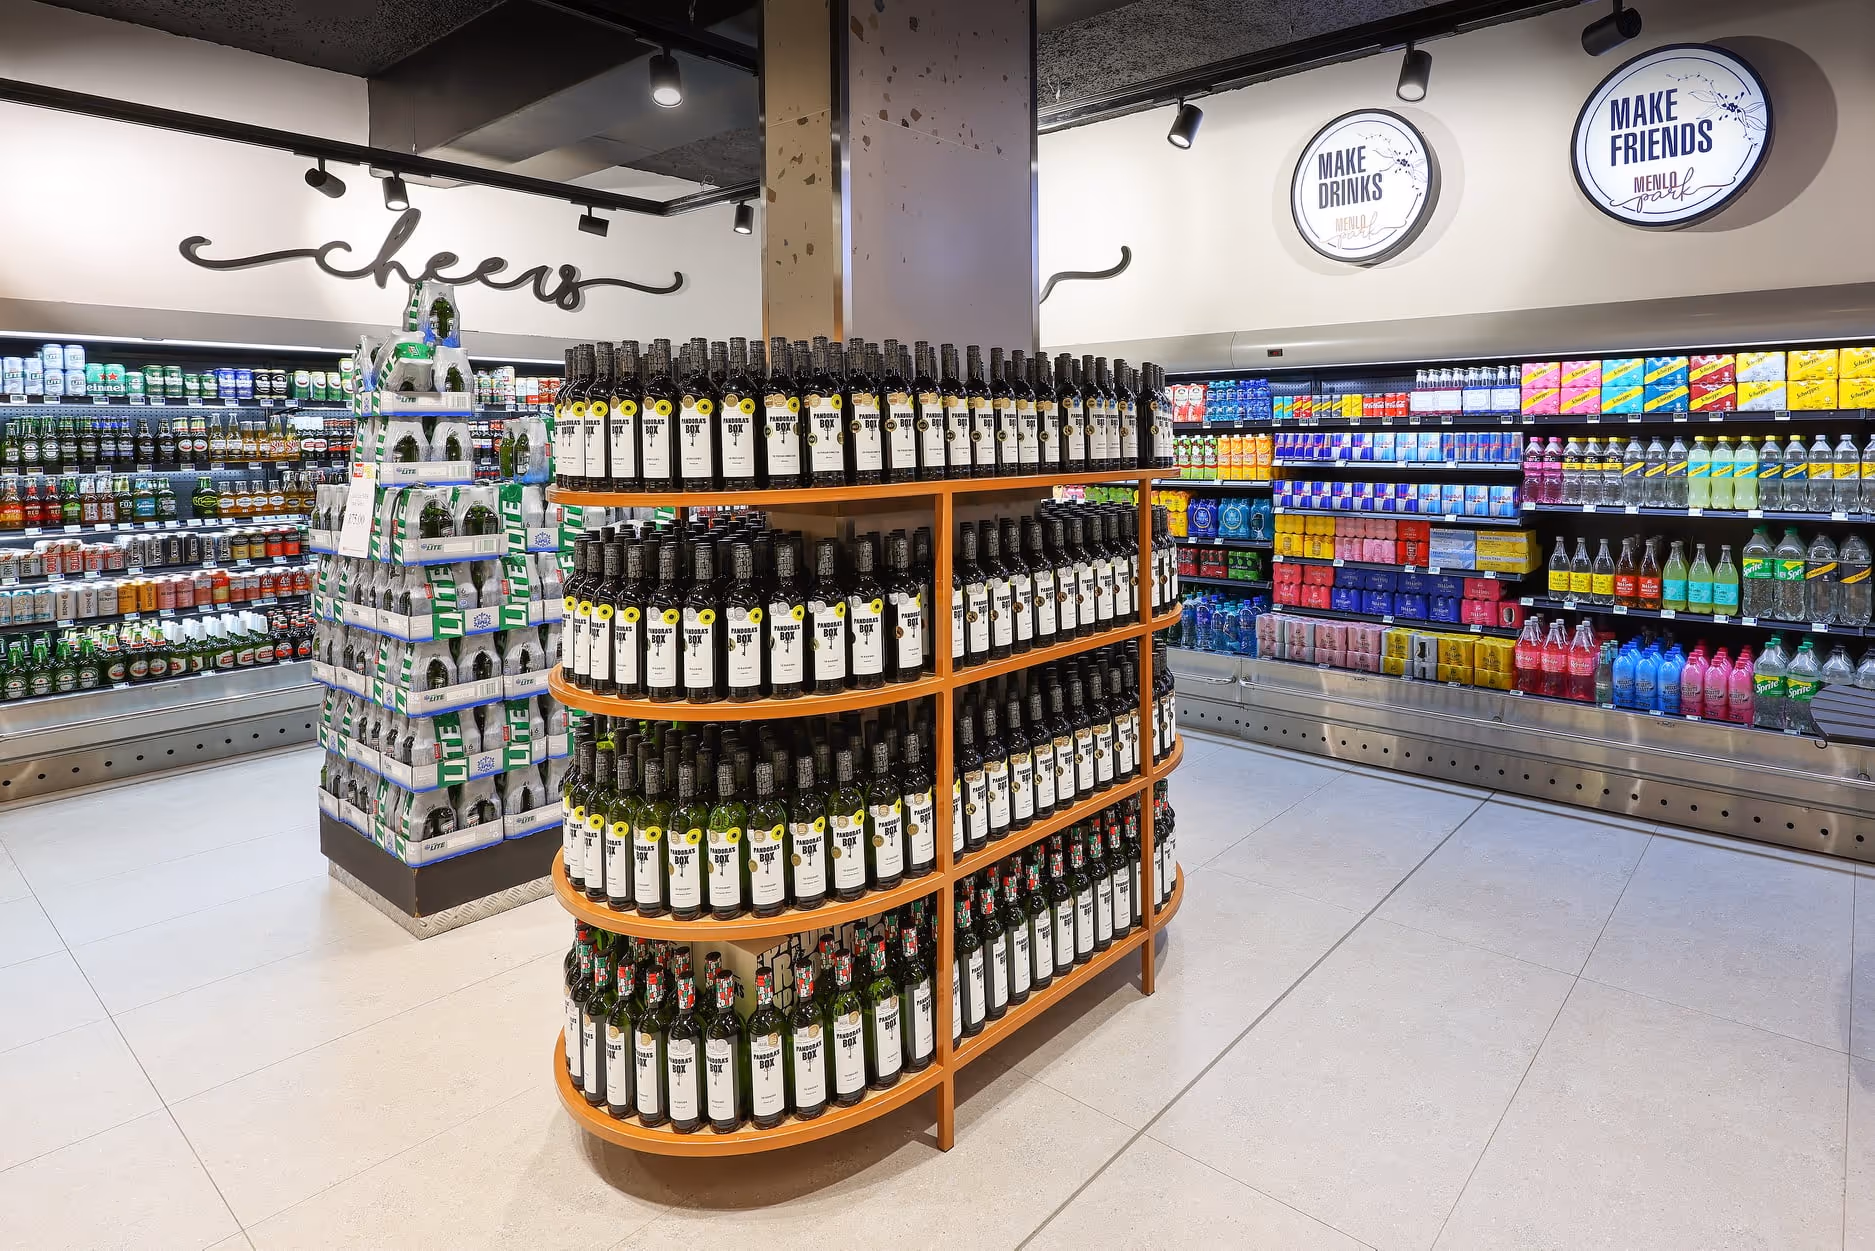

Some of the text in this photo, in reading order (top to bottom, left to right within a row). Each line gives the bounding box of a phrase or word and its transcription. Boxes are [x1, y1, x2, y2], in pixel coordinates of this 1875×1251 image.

[1610, 87, 1678, 131] MAKE
[1610, 119, 1713, 167] FRIENDS
[1318, 145, 1366, 180] MAKE
[1633, 171, 1678, 193] MENLO
[1318, 172, 1383, 209] DRINKS
[1335, 214, 1367, 233] MENLO
[775, 422, 791, 431] BOX
[820, 419, 835, 428] BOX
[865, 419, 878, 428] BOX
[900, 419, 912, 427] BOX
[686, 424, 700, 434] BOX
[728, 424, 744, 433] BOX
[502, 500, 526, 550] LITE
[1743, 563, 1762, 576] Sprite
[504, 563, 528, 622] LITE
[430, 568, 463, 635] LITE
[907, 618, 919, 626] BOX
[824, 628, 838, 637] BOX
[859, 624, 874, 633] BOX
[652, 634, 666, 644] BOX
[688, 634, 702, 644] BOX
[737, 634, 752, 643] BOX
[780, 631, 795, 640] BOX
[1755, 681, 1778, 694] Sprite
[1788, 687, 1811, 699] Sprite
[509, 709, 530, 766] LITE
[438, 724, 468, 782] LITE
[920, 814, 931, 823] BOX
[884, 825, 897, 836] BOX
[430, 841, 445, 850] LITE
[842, 837, 857, 847] BOX
[802, 844, 817, 854] BOX
[636, 852, 648, 861] BOX
[675, 855, 689, 864] BOX
[714, 854, 729, 863] BOX
[759, 852, 775, 862] BOX
[884, 1020, 897, 1030] BOX
[842, 1036, 857, 1047] BOX
[802, 1049, 817, 1060] BOX
[710, 1064, 723, 1073] BOX
[759, 1058, 775, 1069] BOX
[672, 1064, 686, 1074] BOX
